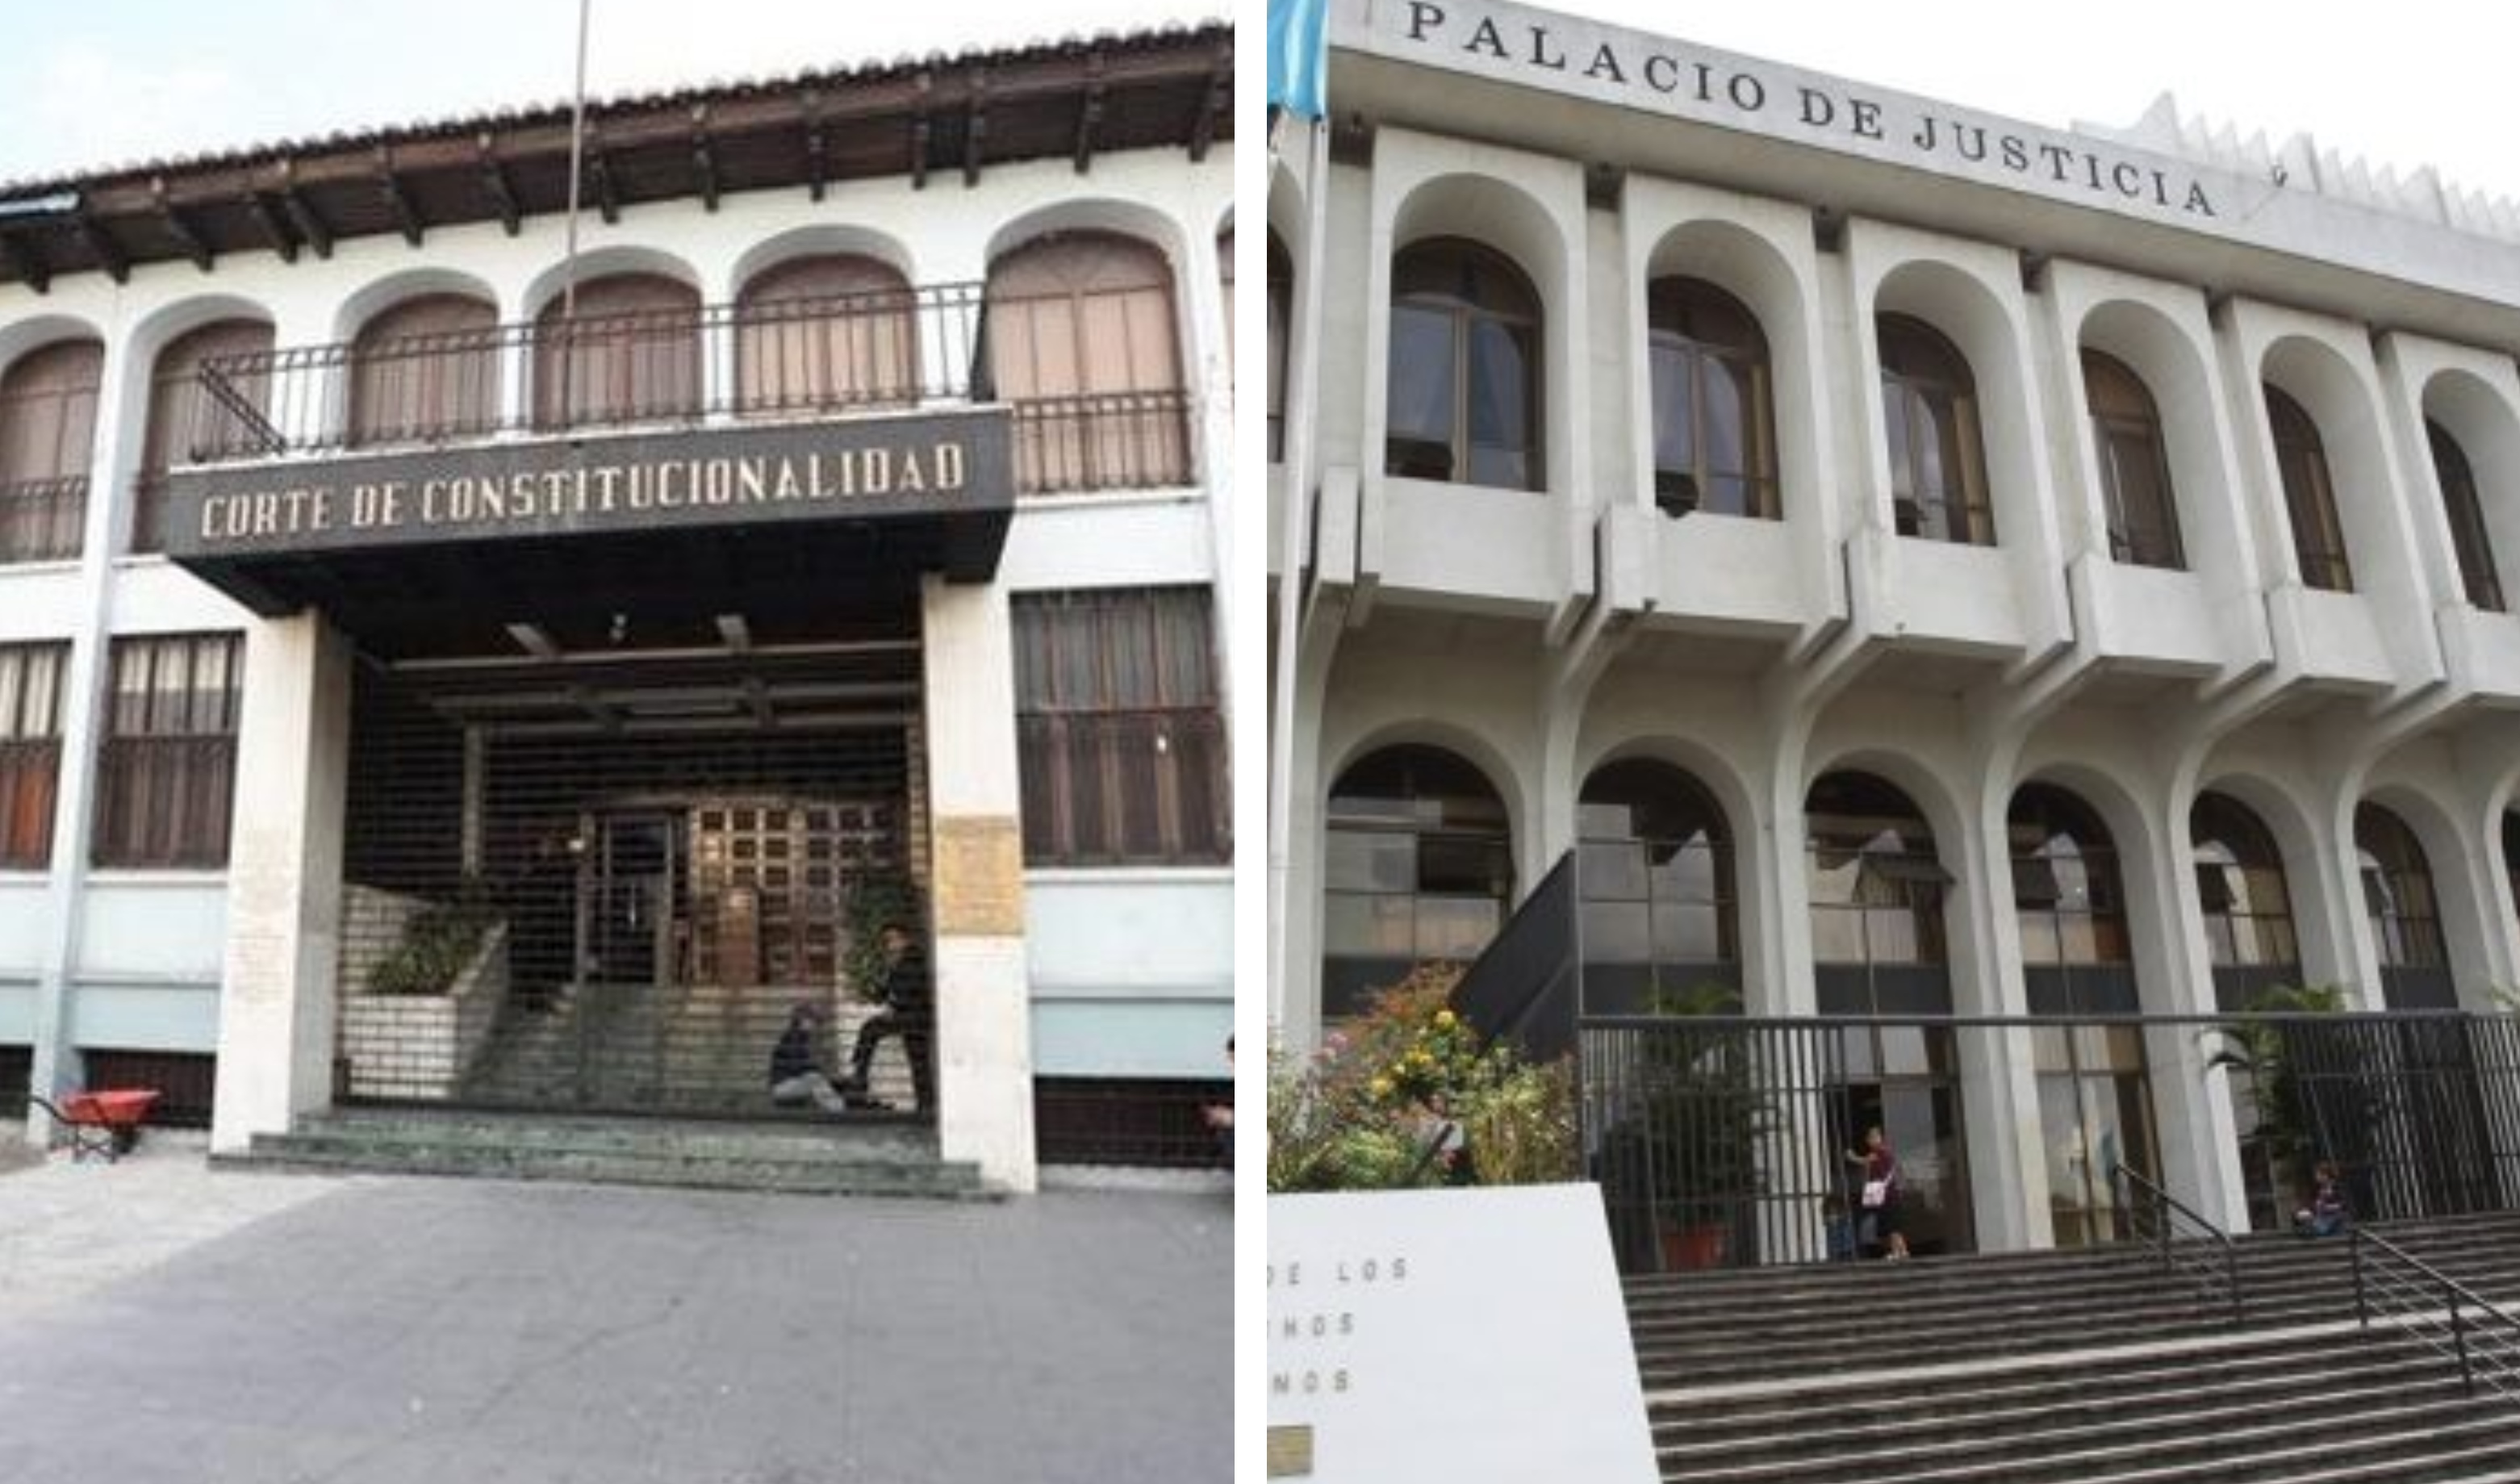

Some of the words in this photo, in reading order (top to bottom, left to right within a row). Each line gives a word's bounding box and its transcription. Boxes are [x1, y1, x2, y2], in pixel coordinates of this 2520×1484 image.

[1409, 2, 1766, 111] PALACIO
[1799, 88, 1883, 140] DE
[1913, 116, 2217, 216] JUSTICIA
[202, 486, 333, 537] CORTE
[353, 482, 405, 527] DE
[423, 444, 964, 522] CONSTITUCIONALIDAD
[1336, 1256, 1406, 1282] LOS
[1267, 1311, 1355, 1340] HOS
[1272, 1369, 1348, 1396] NOS
